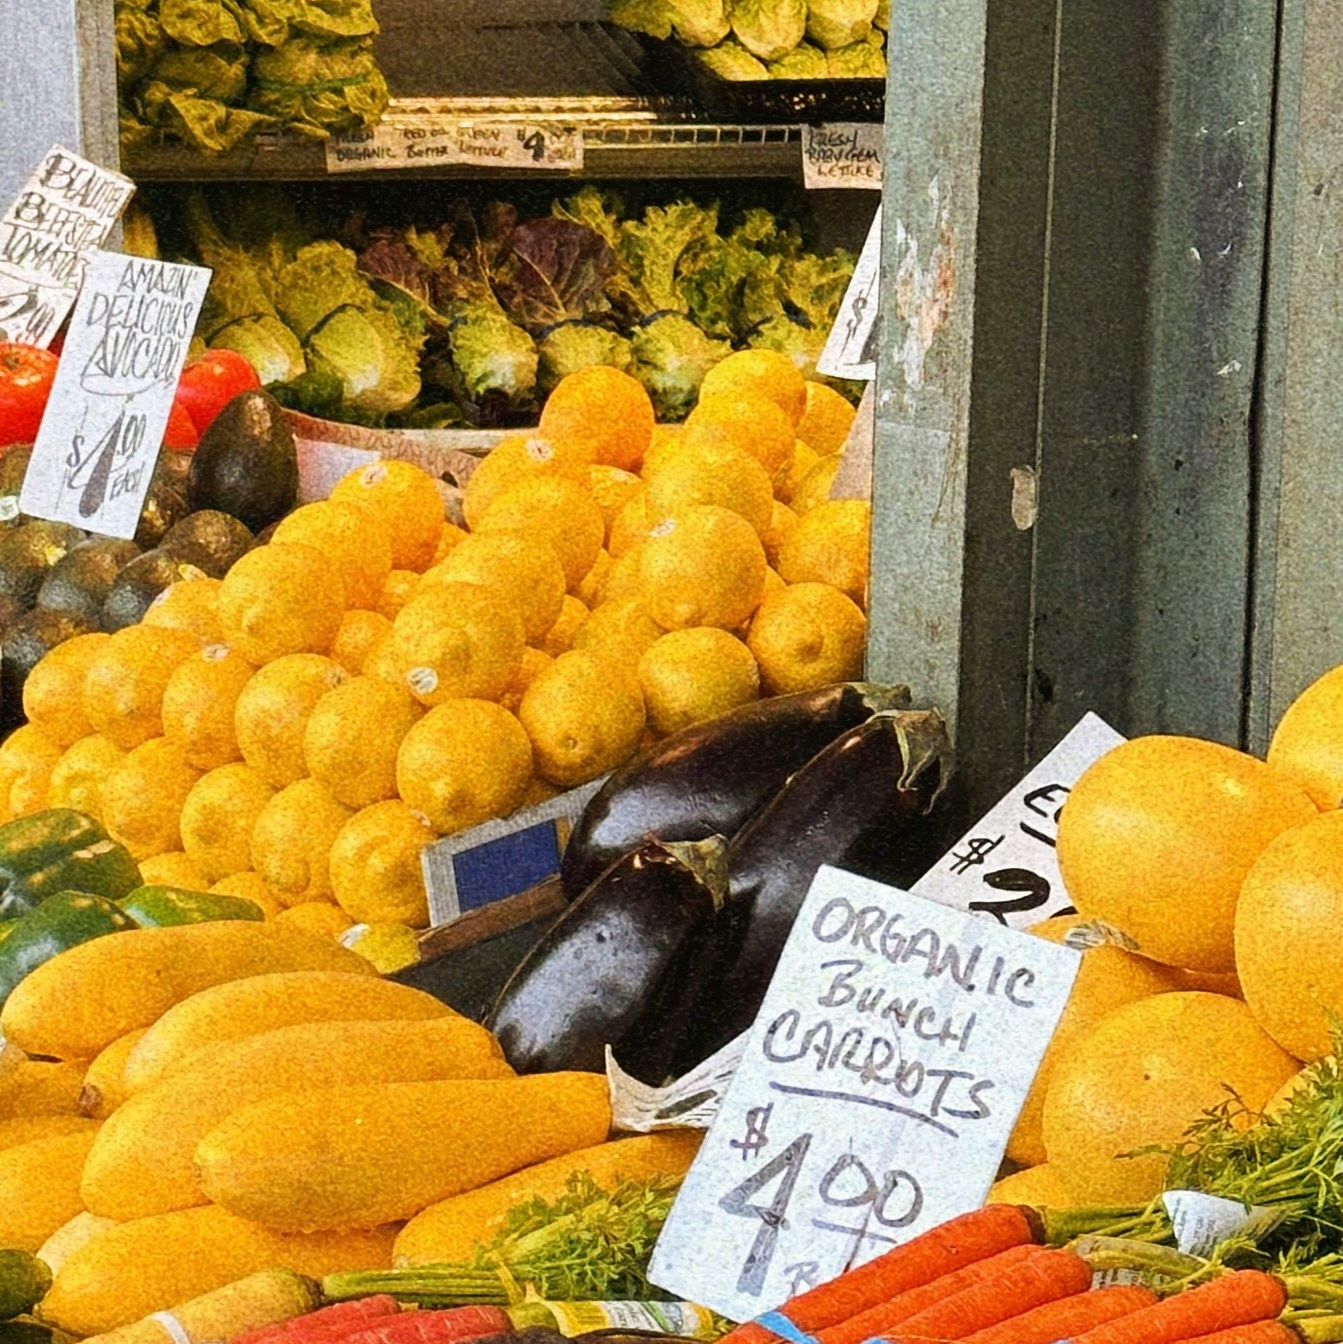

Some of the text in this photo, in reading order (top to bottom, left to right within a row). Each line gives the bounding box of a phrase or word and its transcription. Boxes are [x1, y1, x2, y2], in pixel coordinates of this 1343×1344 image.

[86, 291, 194, 339] DELICIOUS
[812, 897, 1036, 1008] ORGANIC
[819, 958, 977, 1053] BUNCH
[763, 1009, 996, 1120] CARROTS
